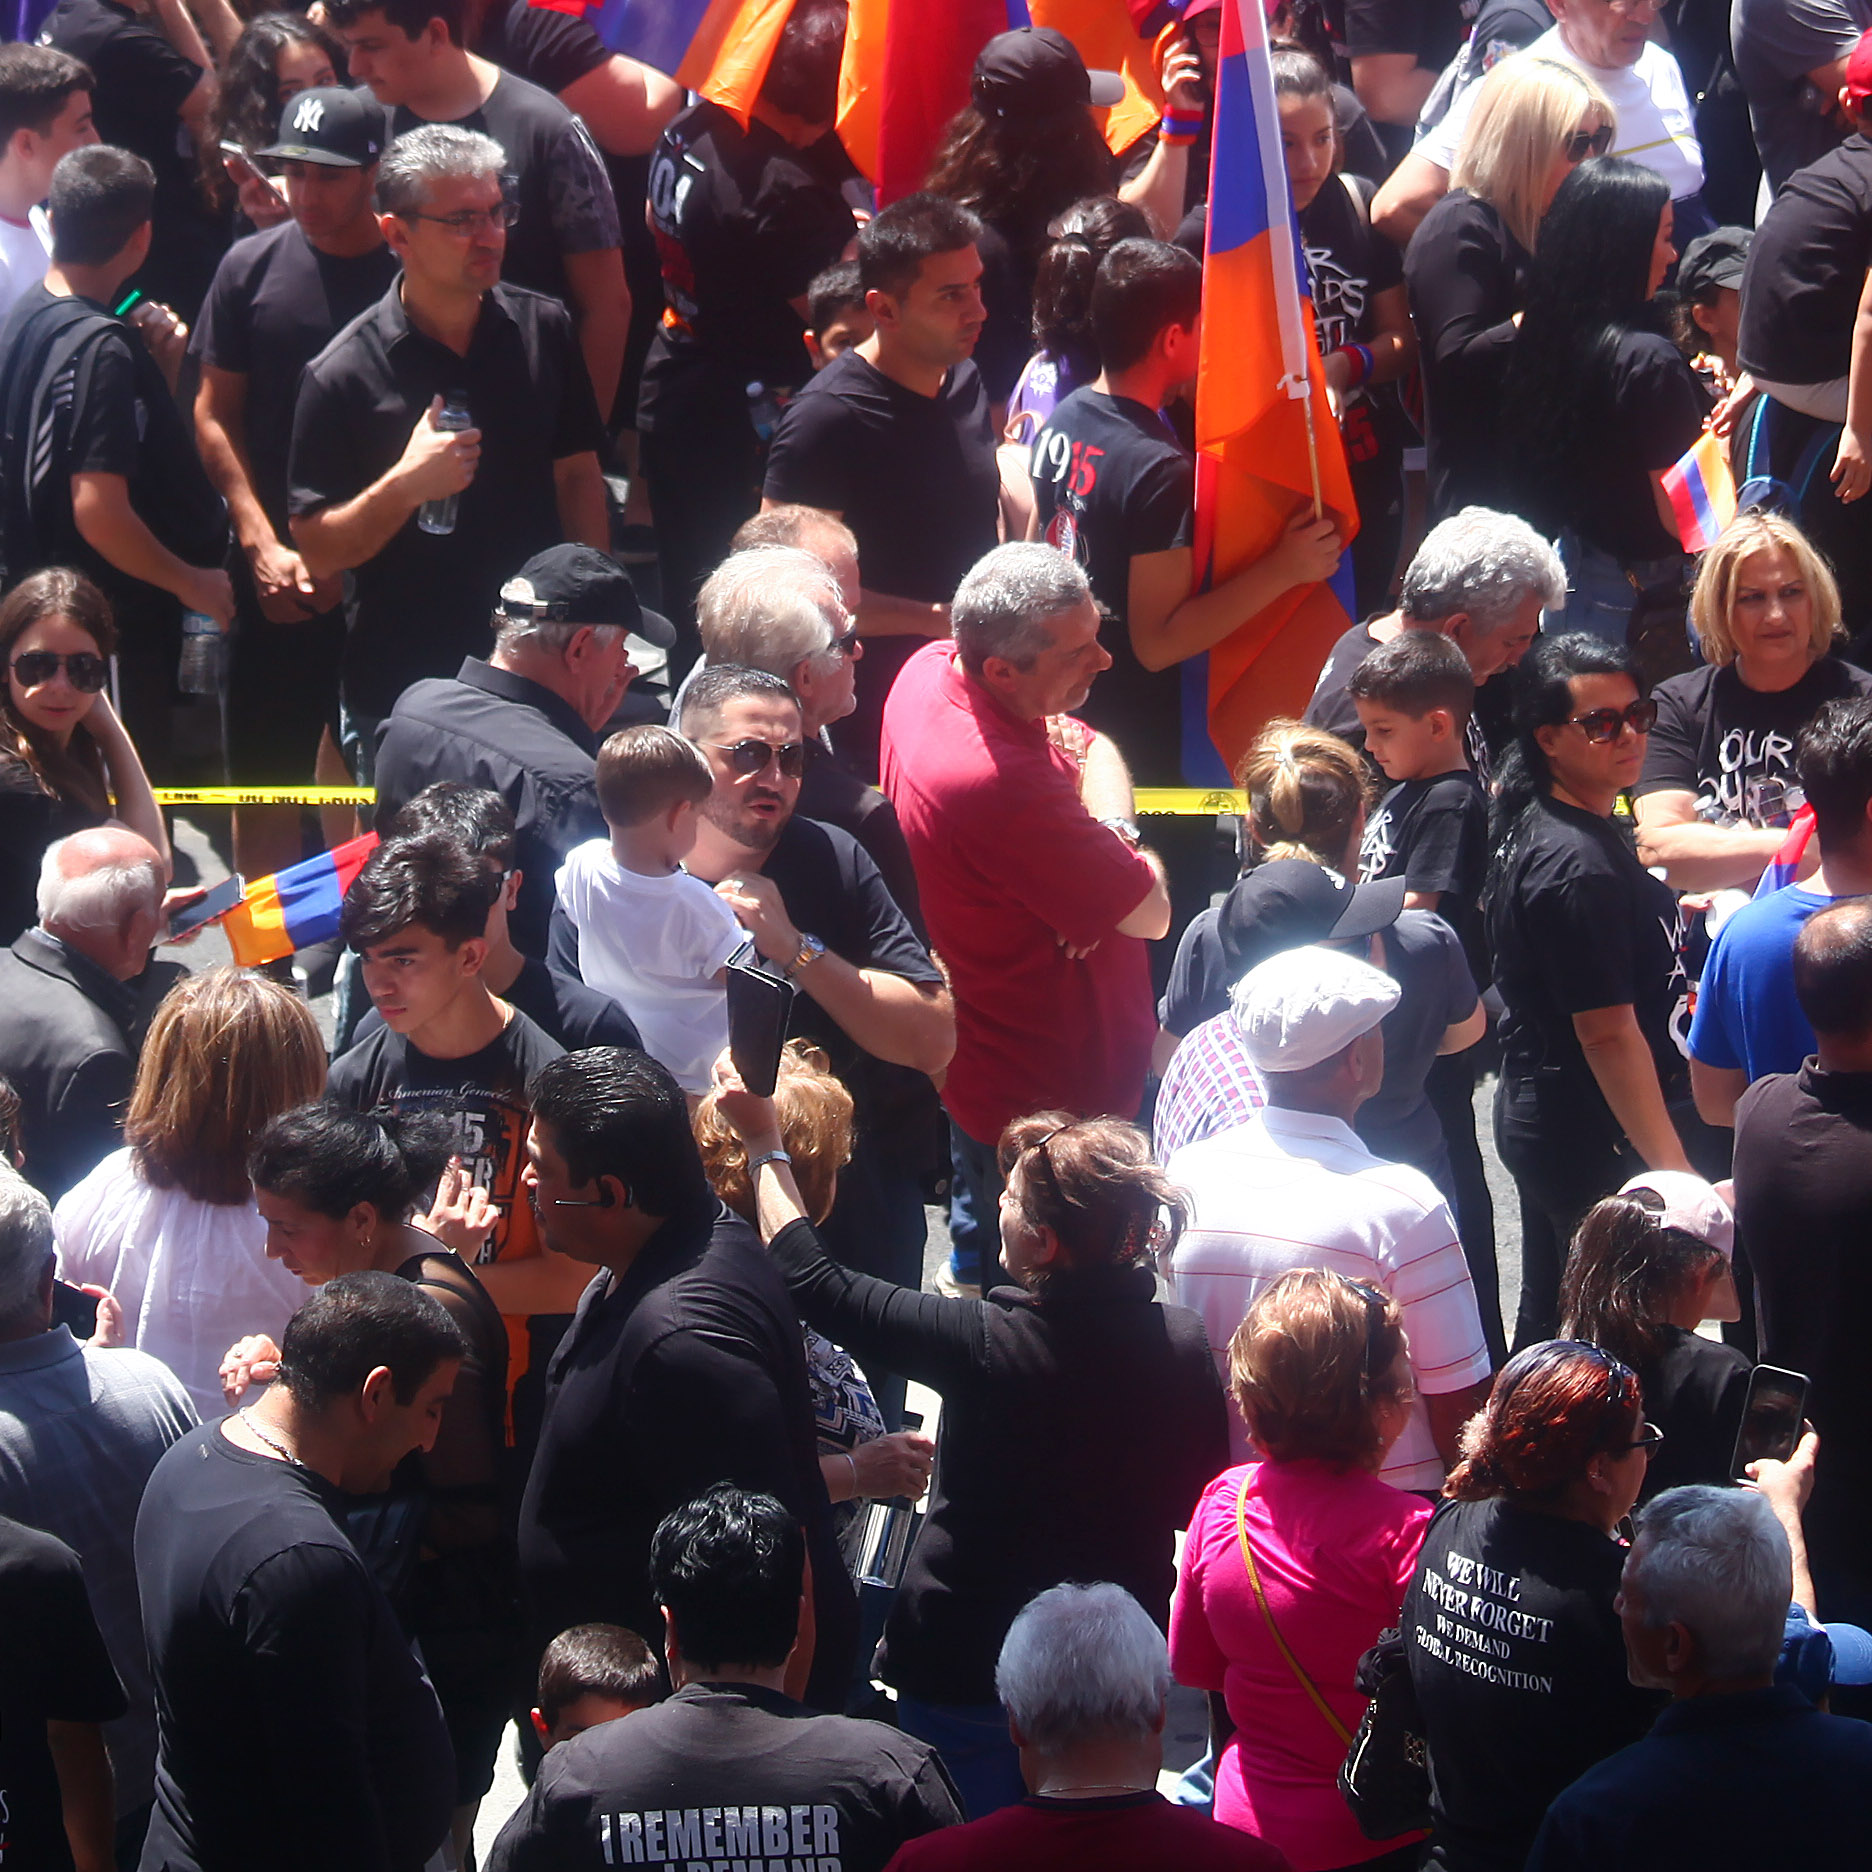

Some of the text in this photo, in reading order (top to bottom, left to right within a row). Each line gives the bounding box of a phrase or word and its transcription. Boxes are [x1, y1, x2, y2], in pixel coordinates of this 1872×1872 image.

[1032, 427, 1106, 497] 1915
[1718, 728, 1793, 773] OUR
[1422, 1568, 1554, 1644] NEVER FORGET
[1447, 1550, 1521, 1602] WE WILL
[1415, 1625, 1553, 1694] GLOBAL RECOGNITION
[1436, 1613, 1511, 1660] WE DEMAND
[600, 1804, 840, 1865] I REMEMBER
